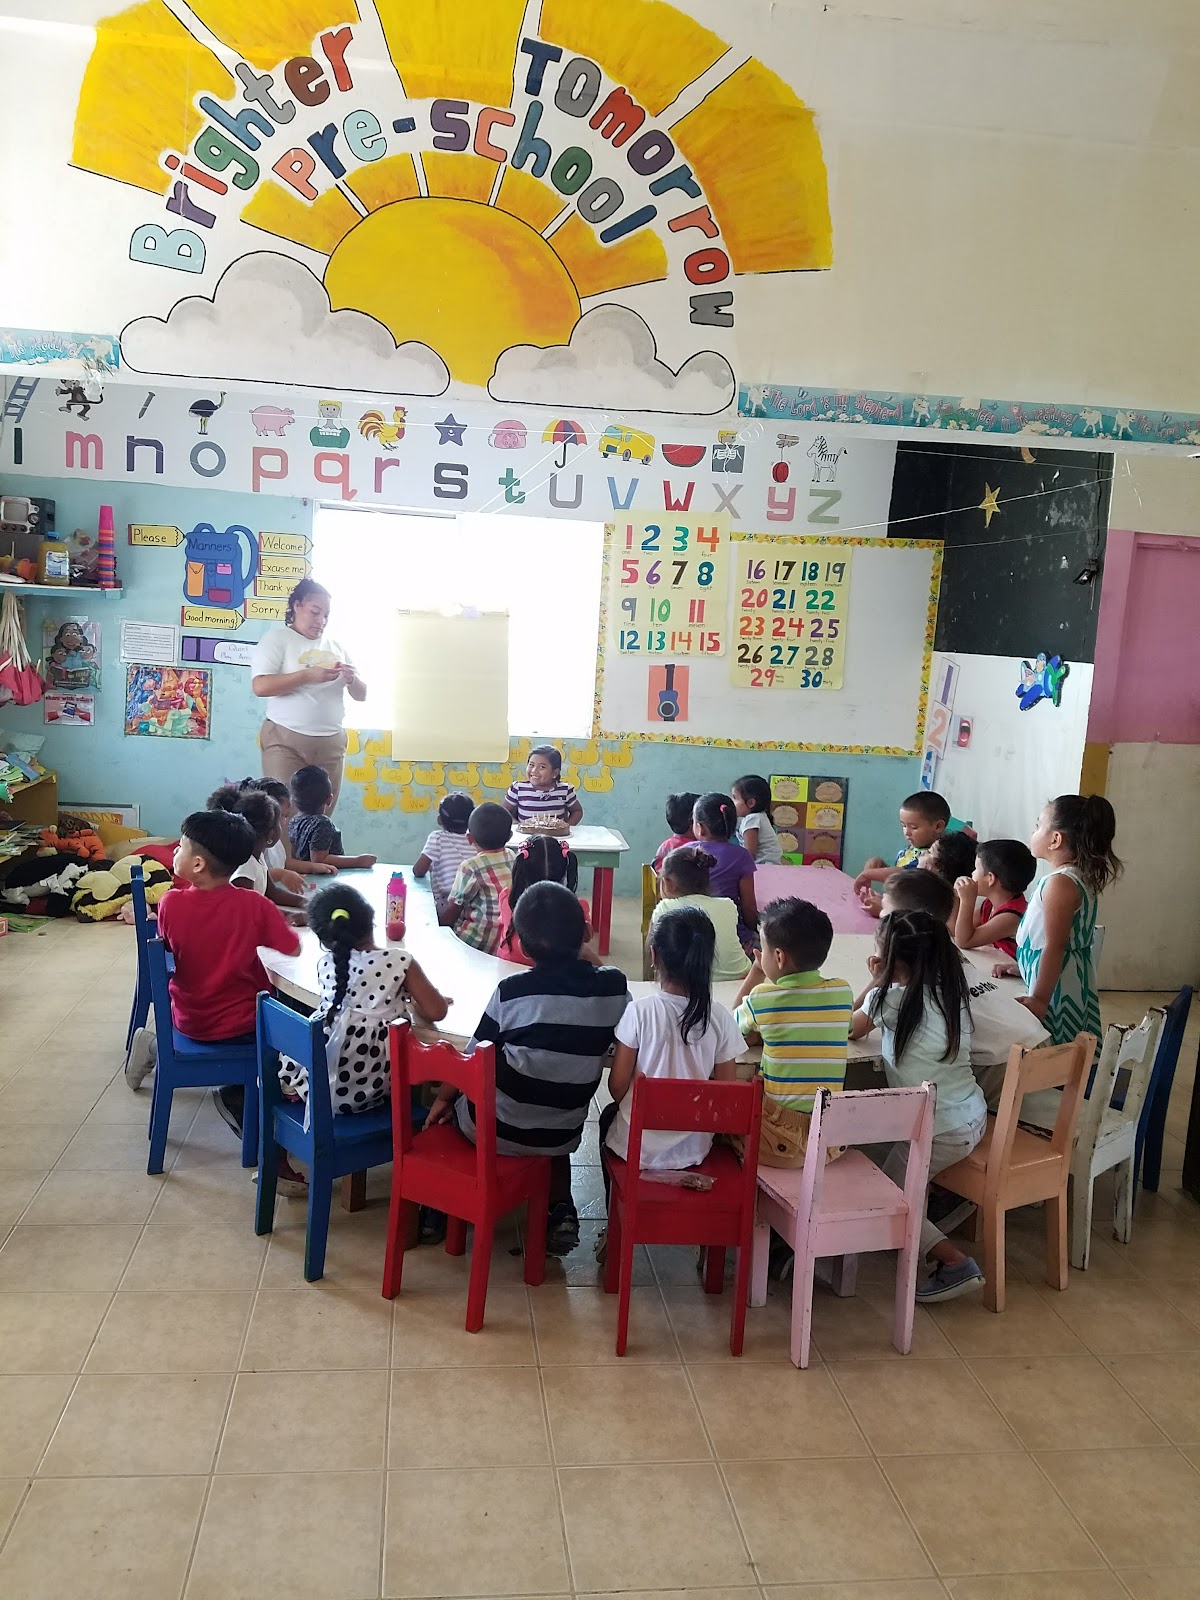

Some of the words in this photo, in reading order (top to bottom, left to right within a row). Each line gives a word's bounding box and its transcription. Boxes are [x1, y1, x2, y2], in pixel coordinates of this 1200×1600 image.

[129, 27, 354, 274] Brighter
[520, 37, 735, 328] Tomorrow
[769, 389, 788, 412] The
[790, 395, 819, 417] Lord
[65, 430, 104, 470] m
[126, 435, 164, 474] n
[252, 446, 289, 493] p
[374, 456, 400, 493] r
[498, 468, 526, 504] t
[133, 528, 167, 543] Please
[188, 538, 232, 552] Manners
[260, 535, 303, 551] Welcome
[626, 524, 633, 550] 1
[641, 524, 661, 551] 2
[672, 526, 690, 552] 3
[696, 526, 720, 553] 4
[261, 558, 290, 572] Excuse
[292, 566, 305, 574] me
[620, 559, 640, 584] 5
[646, 560, 662, 585] 6
[672, 560, 689, 585] 7
[697, 561, 715, 586] 8
[747, 559, 766, 580] 16
[774, 560, 797, 581] 17
[801, 561, 819, 581] 18
[825, 562, 846, 582] 19
[258, 579, 283, 592] Thank
[251, 602, 280, 618] Sorry
[621, 598, 637, 621] 9
[650, 598, 671, 622] 10
[689, 599, 705, 623] 11
[741, 588, 768, 608] 20
[772, 589, 796, 610] 21
[805, 589, 836, 611] 22
[184, 610, 204, 622] Good
[204, 616, 235, 629] morning
[740, 616, 765, 636] 23
[772, 617, 804, 638] 24
[810, 618, 840, 639] 25
[620, 630, 640, 650] 12
[647, 631, 666, 651] 13
[670, 631, 692, 651] 14
[699, 632, 720, 651] 15
[737, 643, 764, 664] 26
[770, 645, 800, 666] 27
[805, 646, 834, 666] 28
[751, 668, 776, 687] 29
[800, 669, 823, 688] 30
[927, 708, 948, 749] 2
